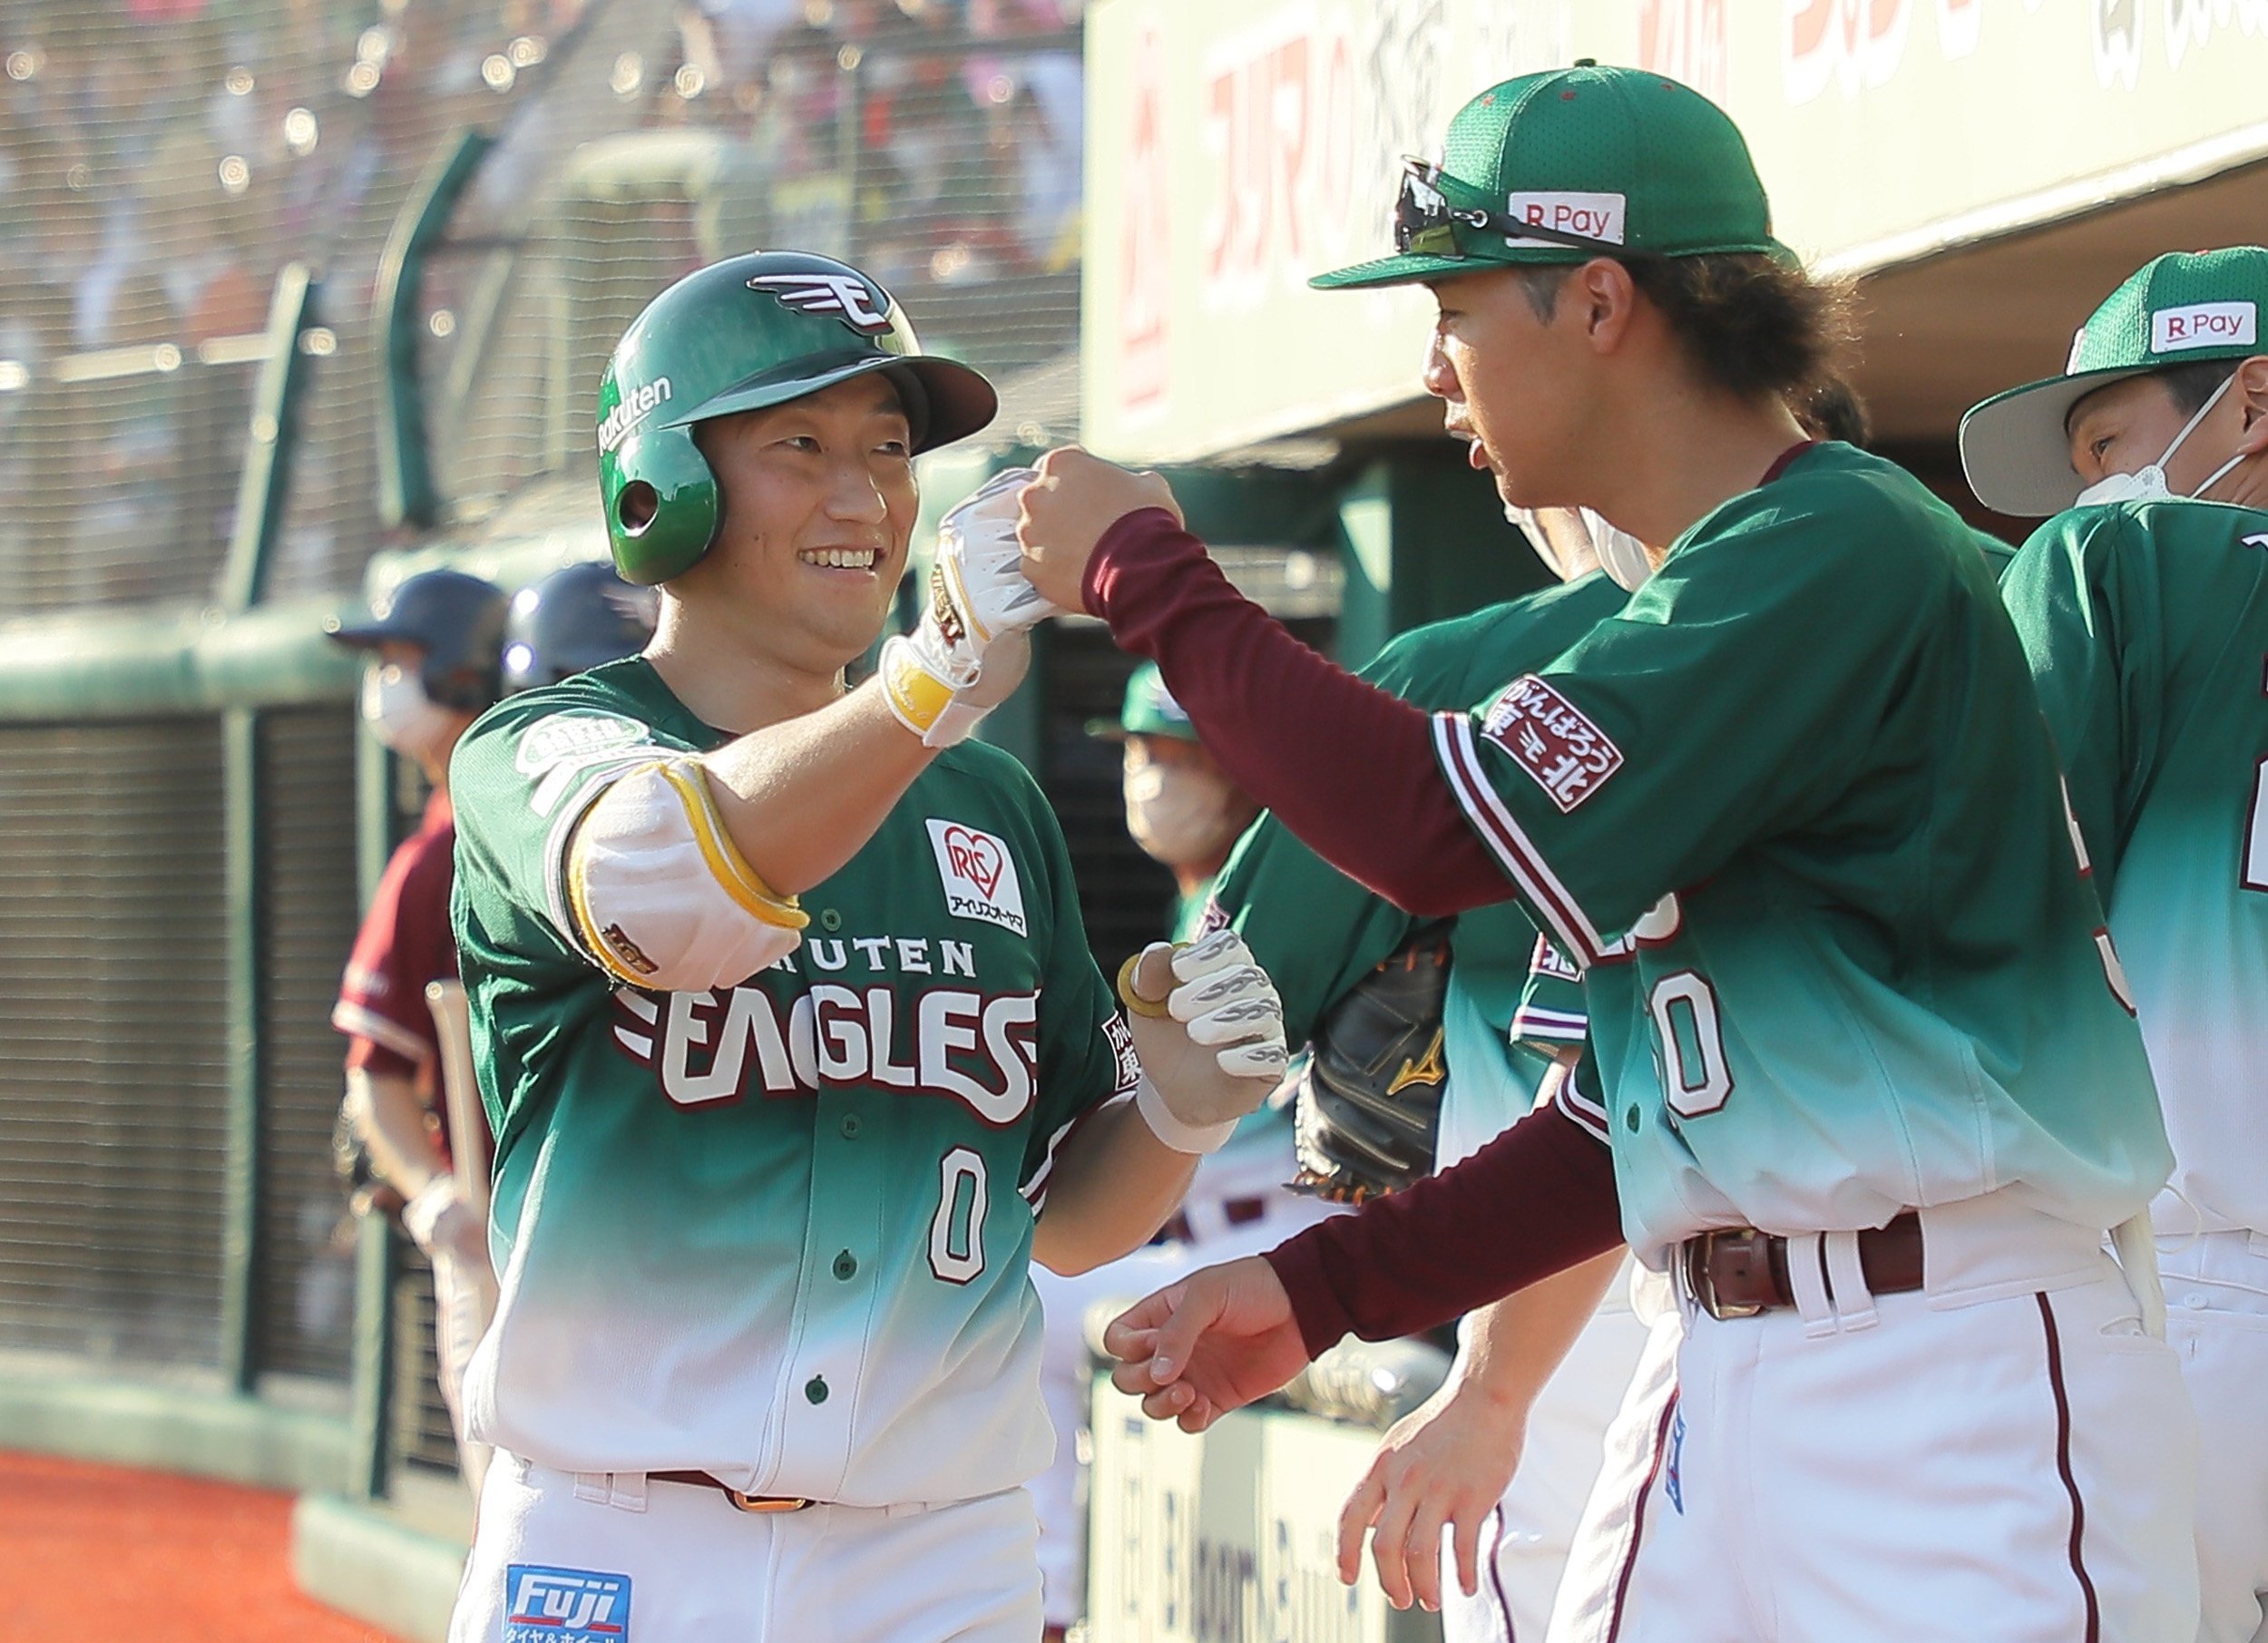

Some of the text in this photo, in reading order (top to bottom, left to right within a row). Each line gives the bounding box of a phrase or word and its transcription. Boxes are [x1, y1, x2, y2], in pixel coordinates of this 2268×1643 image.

[1554, 205, 1610, 238] Pay
[2168, 314, 2244, 338] R Pay
[597, 376, 672, 458] Rakuten
[1504, 679, 1614, 774] がんばろう
[945, 843, 992, 885] IRIS
[950, 895, 1024, 932] アイリスオーヤマ
[769, 934, 978, 980] UTEN
[660, 983, 1038, 1125] EAGLES
[927, 1144, 989, 1285] 0
[513, 1573, 620, 1628] Fuji
